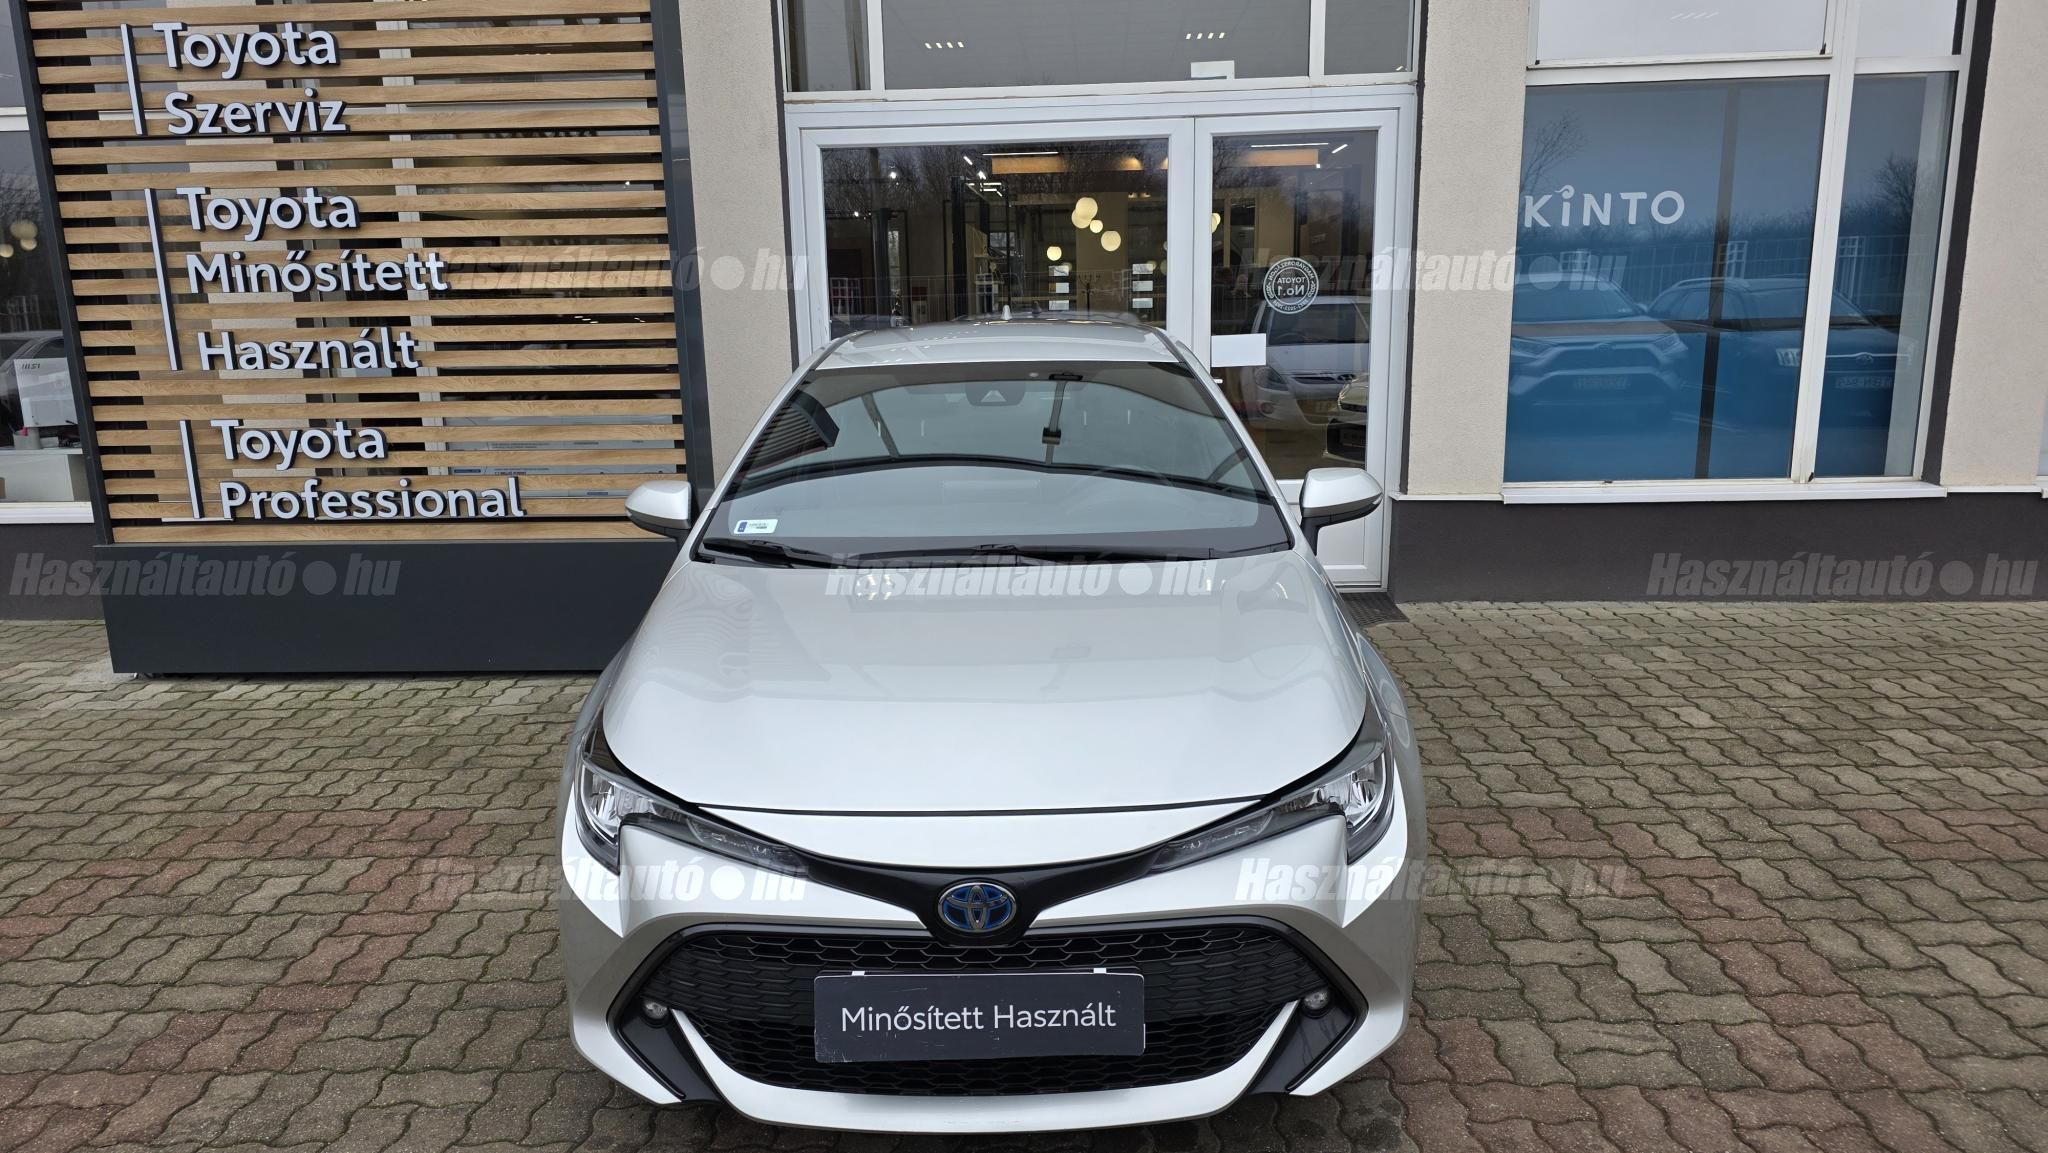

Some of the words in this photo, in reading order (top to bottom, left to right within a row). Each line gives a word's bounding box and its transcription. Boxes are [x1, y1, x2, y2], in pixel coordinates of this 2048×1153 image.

[153, 22, 339, 78] Toyota
[164, 88, 348, 134] Szerviz
[177, 187, 359, 241] Toyota
[186, 250, 449, 294] Minősített
[198, 328, 420, 371] Használt
[211, 419, 387, 470] Toyota
[220, 477, 526, 521] Professional
[841, 1005, 984, 1032] Minősített
[994, 1002, 1117, 1029] Használt
